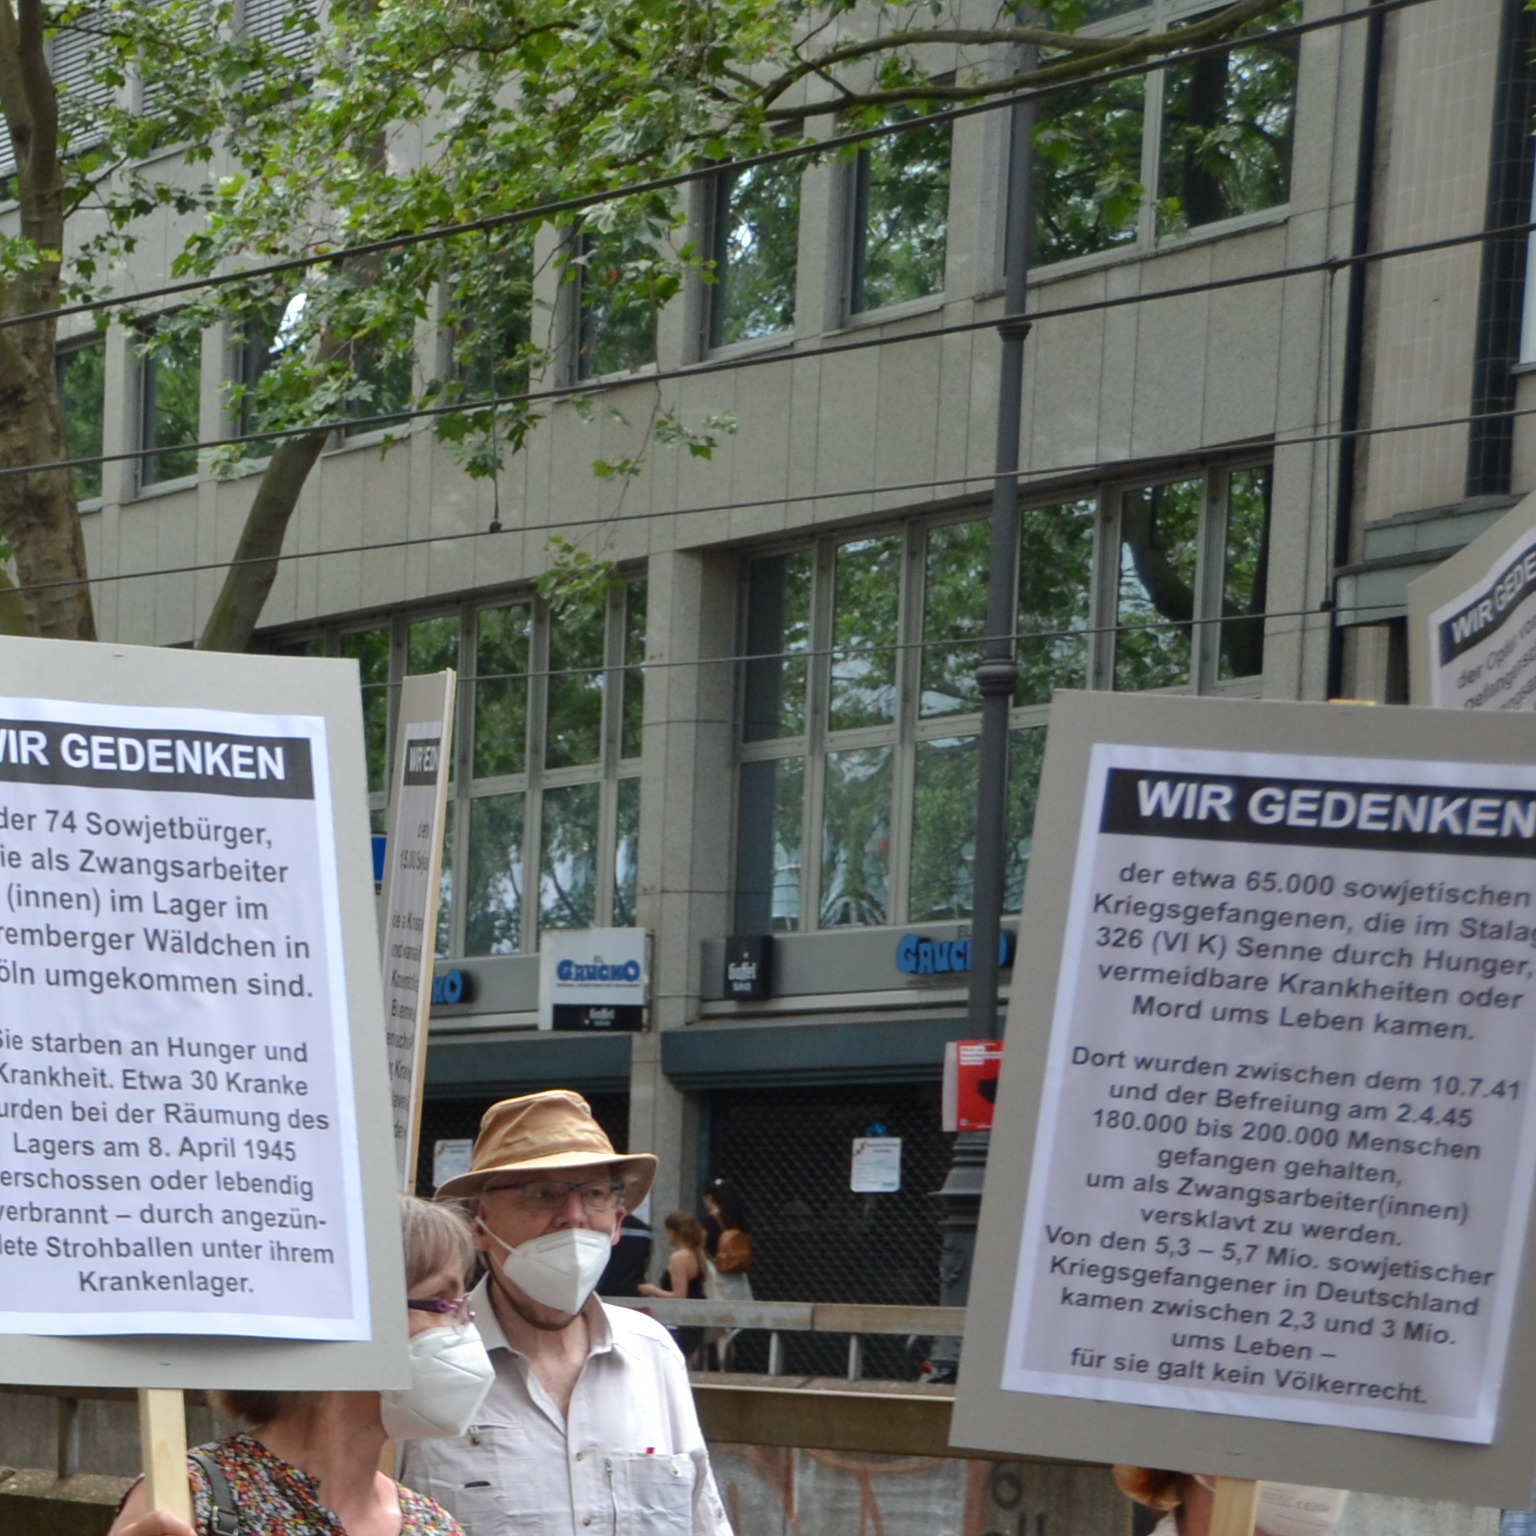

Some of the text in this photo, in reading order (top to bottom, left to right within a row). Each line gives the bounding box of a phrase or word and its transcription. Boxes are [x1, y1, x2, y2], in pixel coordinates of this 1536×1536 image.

[1451, 599, 1494, 643] WIR
[60, 733, 285, 780] GEDENKEN
[45, 809, 78, 834] 74
[86, 811, 272, 850] Sowjetbürger,
[1138, 780, 1536, 837] WIR GEDENKEN
[31, 847, 70, 872] als
[79, 848, 289, 884] Zwangsarbeiter
[1119, 862, 1531, 907] der etwa 65.000 sowjetischen
[7, 882, 269, 923] (innen) im Lager im
[1093, 893, 1353, 934] Kriegsgefangenen,
[1364, 912, 1406, 934] die
[1415, 915, 1449, 936] im
[142, 927, 276, 958] Wäldchen
[285, 935, 310, 959] in
[1096, 926, 1533, 980] 326 (VI K) Senne durch Hunger,
[45, 966, 238, 995] umgekommen
[247, 972, 313, 998] sind.
[1098, 964, 1525, 1009] vermeidbare Krankheiten oder
[1132, 994, 1474, 1041] Mord ums Leben kamen.
[31, 1032, 123, 1056] starben
[130, 1040, 159, 1057] an
[167, 1036, 257, 1065] Hunger
[264, 1041, 308, 1063] und
[122, 1068, 183, 1091] Etwa
[190, 1069, 218, 1091] 30
[225, 1071, 309, 1096] Kranke
[1072, 1046, 1521, 1100] Dort wurden zwischen dem 10.7.41
